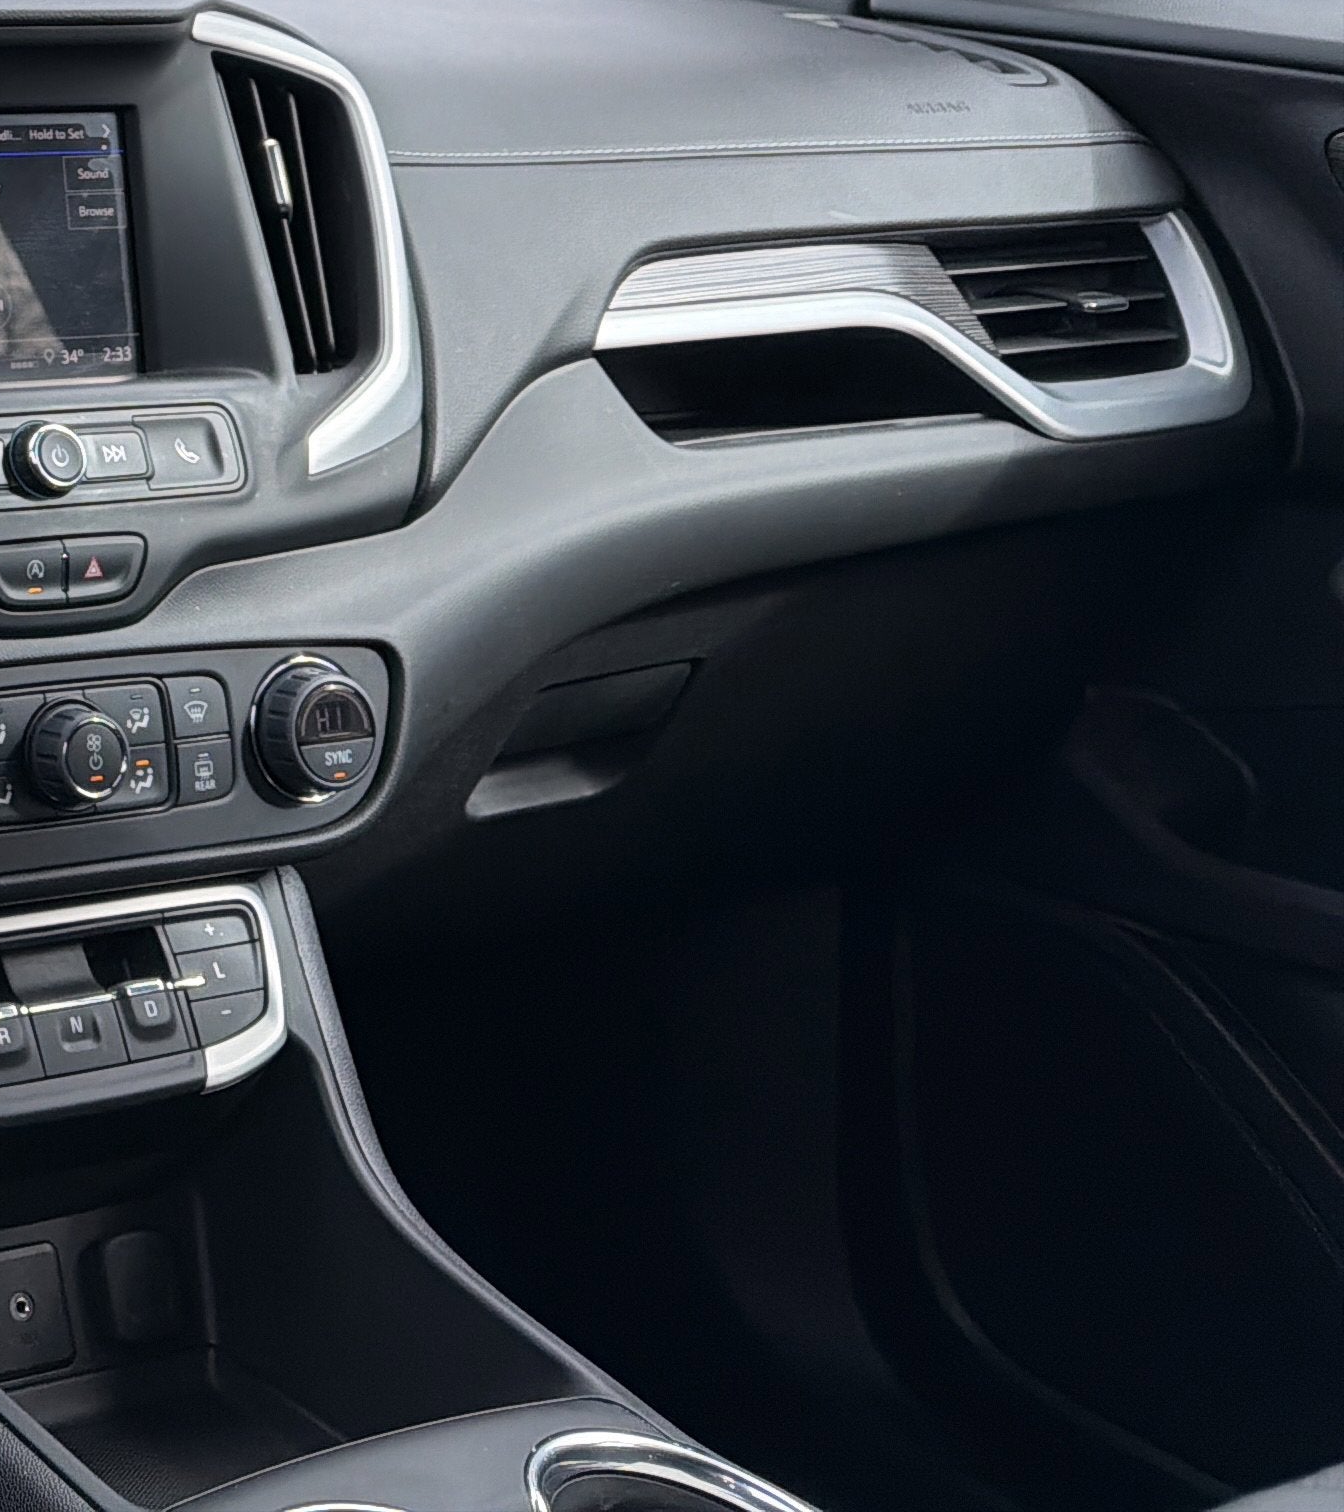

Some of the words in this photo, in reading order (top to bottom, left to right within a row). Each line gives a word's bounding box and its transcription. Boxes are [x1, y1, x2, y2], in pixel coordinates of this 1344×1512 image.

[29, 128, 54, 140] Hold
[55, 129, 66, 140] to
[67, 127, 85, 140] Set
[77, 167, 110, 180] Sound
[78, 205, 115, 218] Browse
[103, 346, 133, 362] 2:33
[324, 748, 353, 767] SYNC
[194, 778, 216, 792] REAR
[212, 961, 226, 980] L
[143, 1001, 158, 1018] D
[69, 1015, 84, 1034] N
